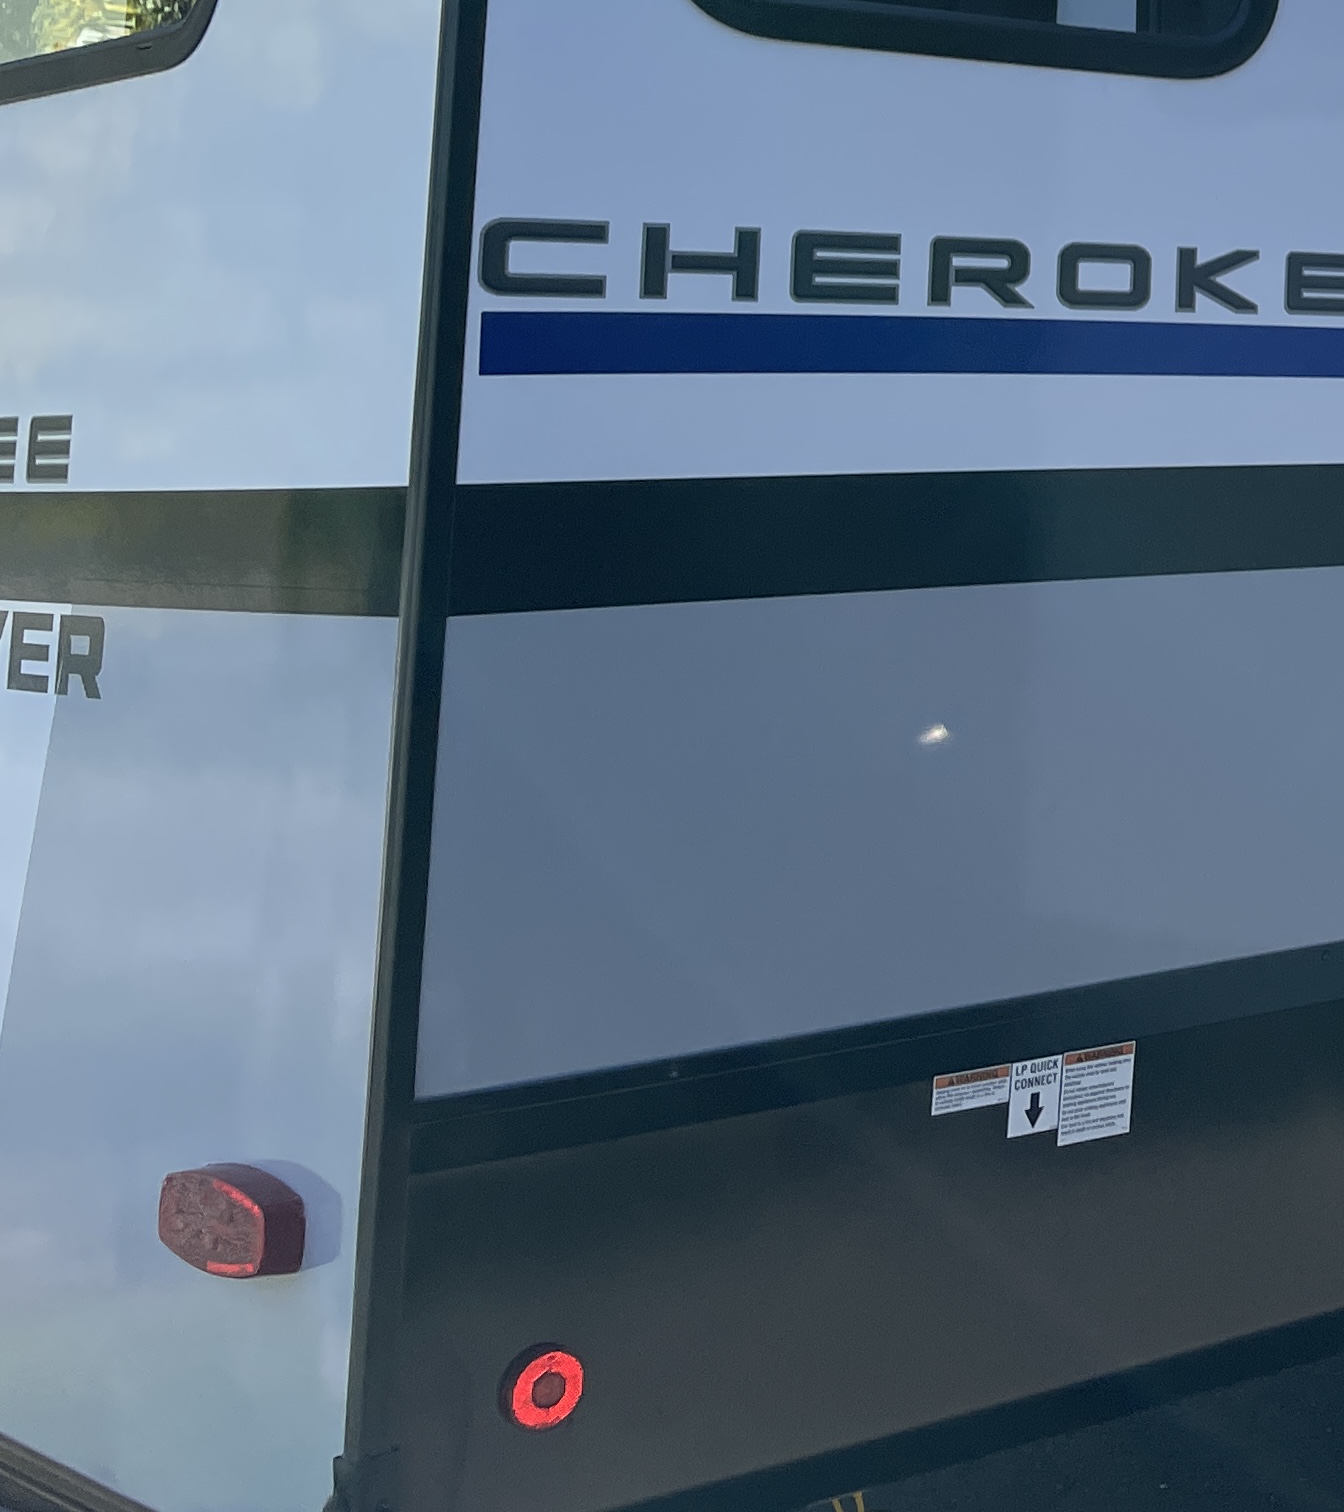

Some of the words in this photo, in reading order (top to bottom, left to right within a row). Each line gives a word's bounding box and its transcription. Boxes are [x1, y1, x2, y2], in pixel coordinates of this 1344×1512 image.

[0, 610, 105, 700] ER
[1015, 1064, 1028, 1076] LP
[1030, 1058, 1059, 1074] QUICK
[1014, 1073, 1058, 1091] CONNECT
